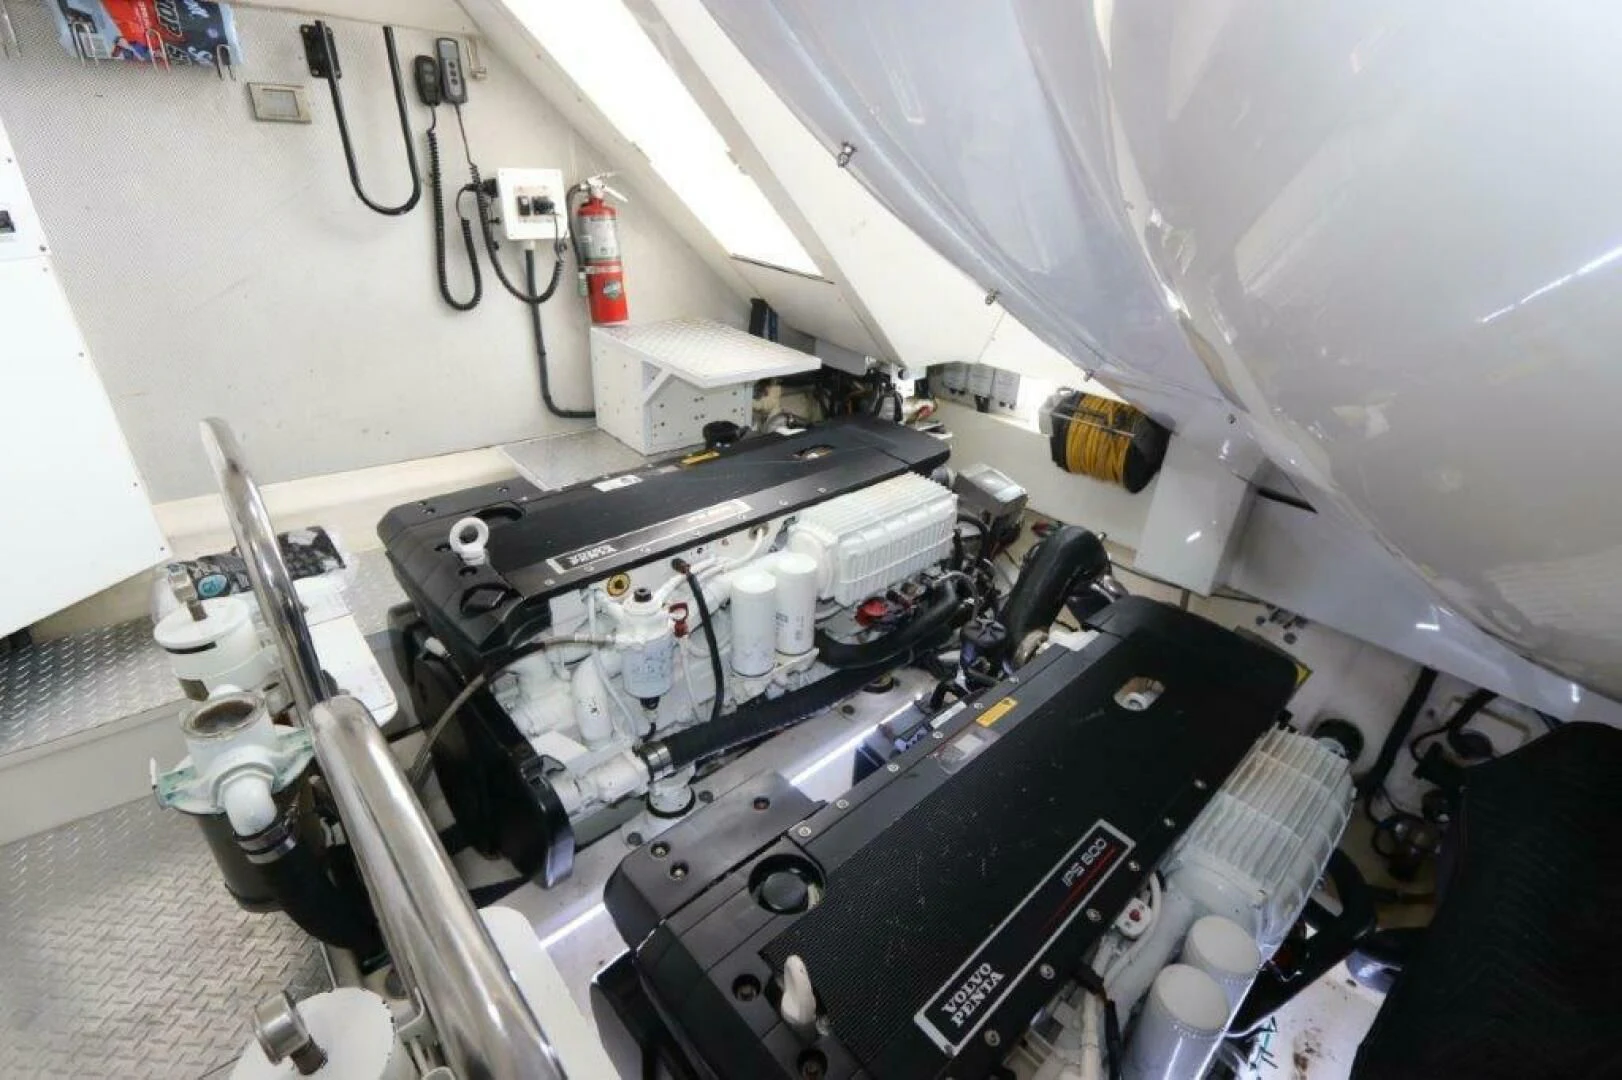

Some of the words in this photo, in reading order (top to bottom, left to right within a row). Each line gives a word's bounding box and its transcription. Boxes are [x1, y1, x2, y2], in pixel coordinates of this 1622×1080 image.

[1062, 862, 1085, 887] IPS
[941, 963, 991, 1013] VOLVO
[951, 971, 1005, 1028] PENTA
